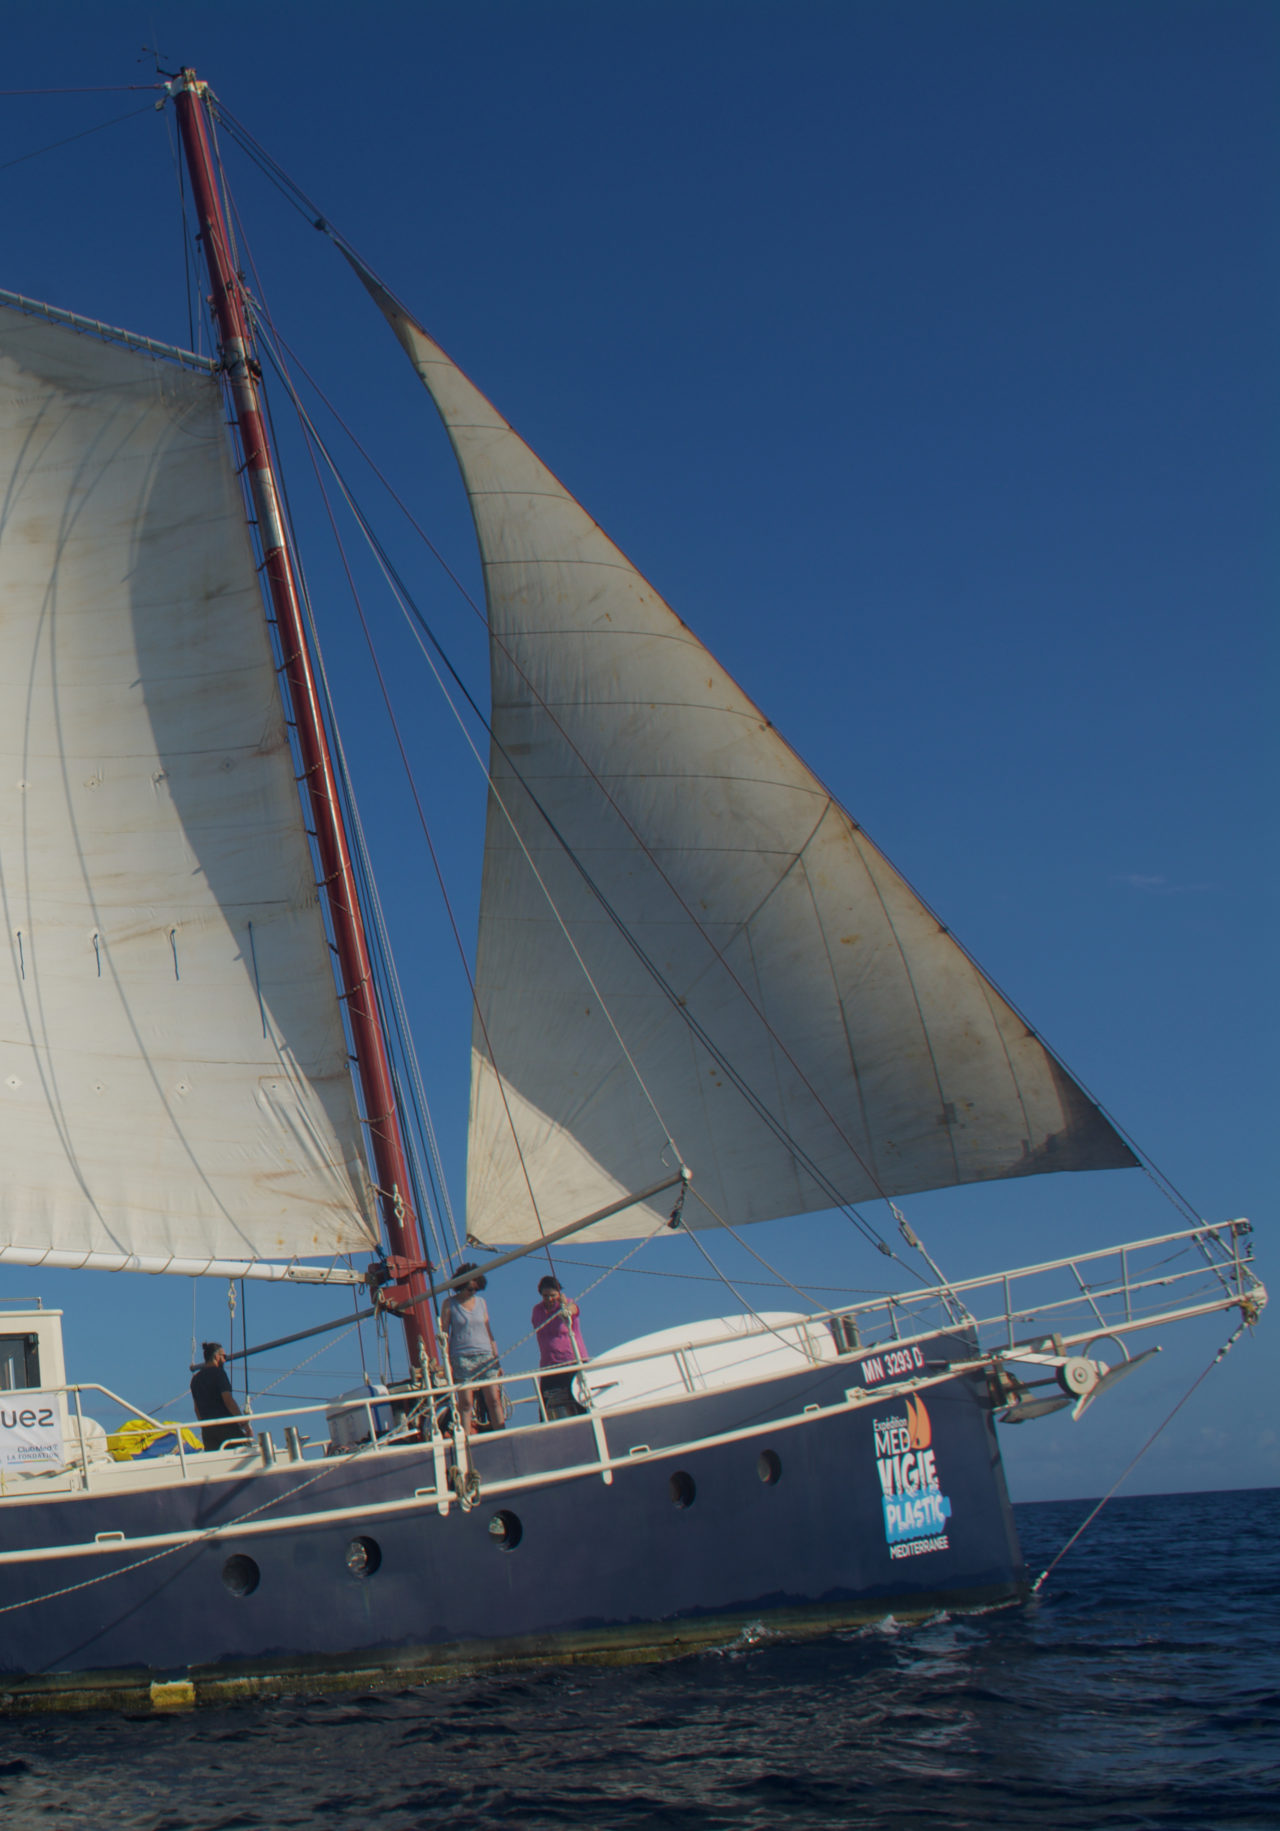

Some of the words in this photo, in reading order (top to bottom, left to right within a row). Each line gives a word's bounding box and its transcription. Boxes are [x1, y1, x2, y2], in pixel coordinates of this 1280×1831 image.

[861, 1357, 886, 1384] MN
[884, 1349, 914, 1376] 3293
[911, 1346, 925, 1369] D
[874, 1427, 911, 1458] MED
[876, 1448, 940, 1501] VIGIE
[886, 1495, 946, 1534] PLASTIC
